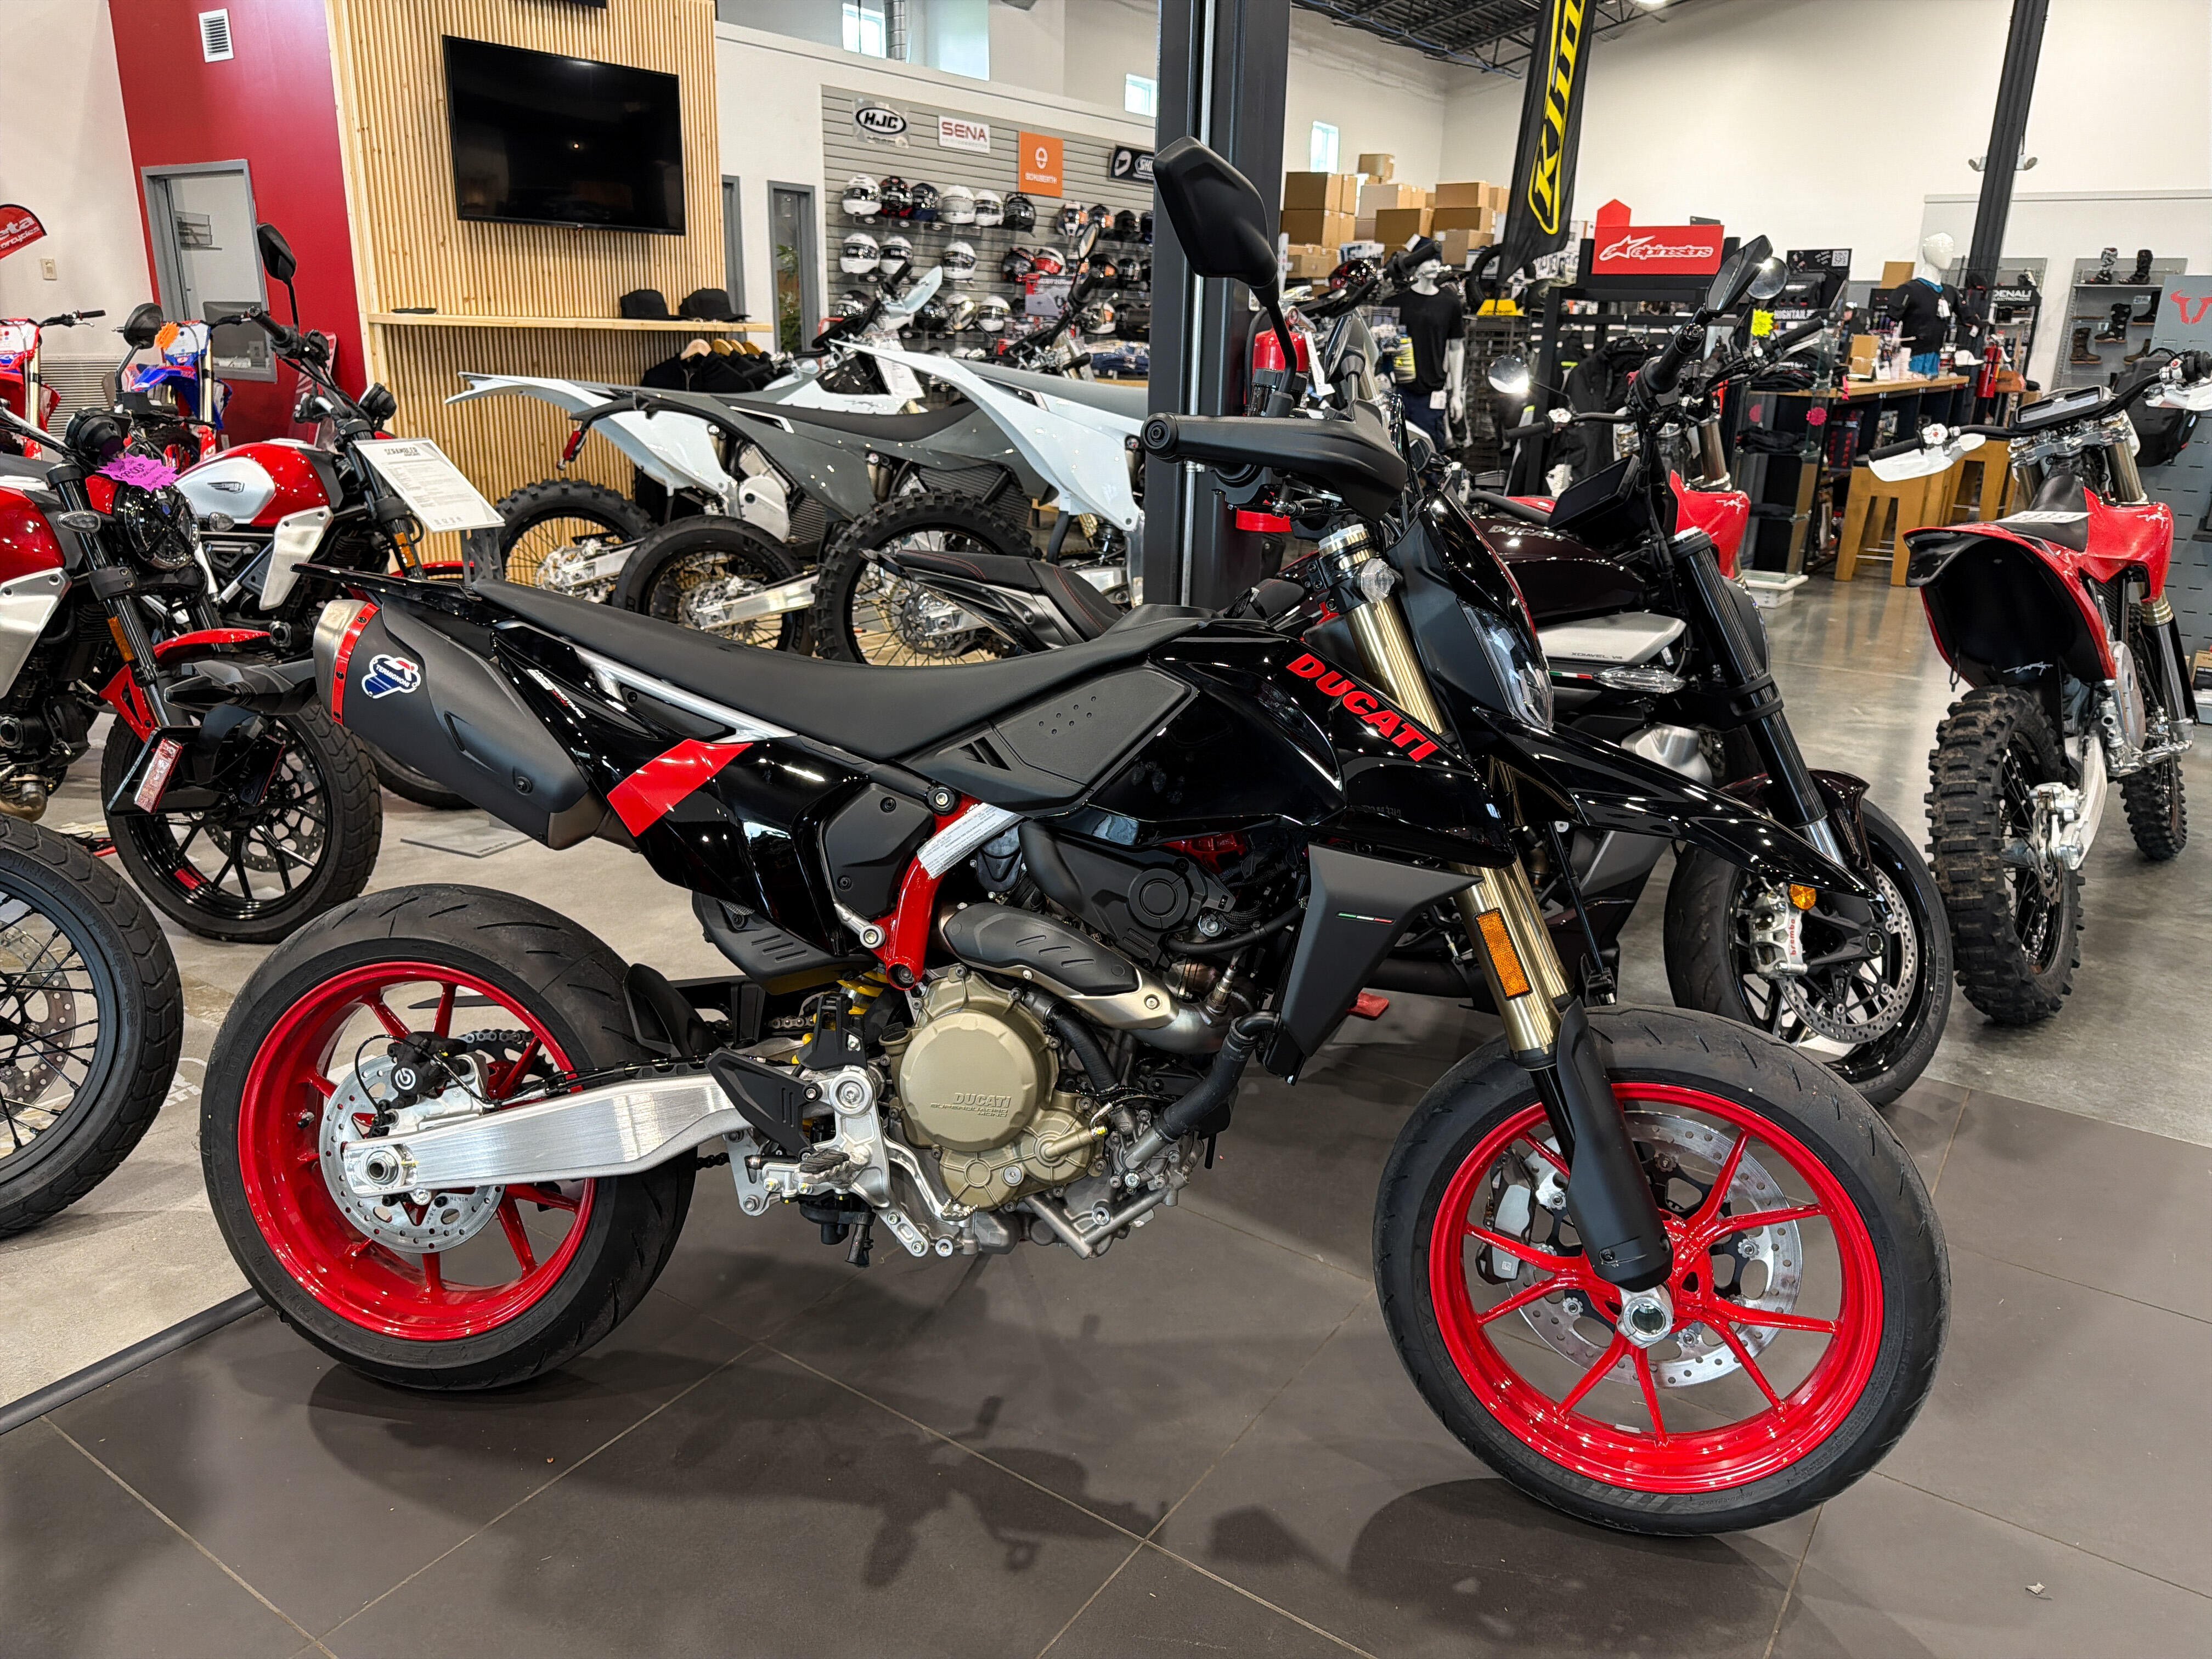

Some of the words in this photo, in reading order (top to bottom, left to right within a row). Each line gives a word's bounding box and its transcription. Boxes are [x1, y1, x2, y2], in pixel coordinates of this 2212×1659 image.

[864, 112, 899, 129] HJC
[941, 121, 987, 142] SENA
[0, 217, 35, 241] eta
[376, 664, 410, 687] TERMIGNONI
[1285, 652, 1439, 762] DUCATI
[930, 1102, 1008, 1114] SUPERQUADRO
[952, 1092, 1012, 1108] DUCATI
